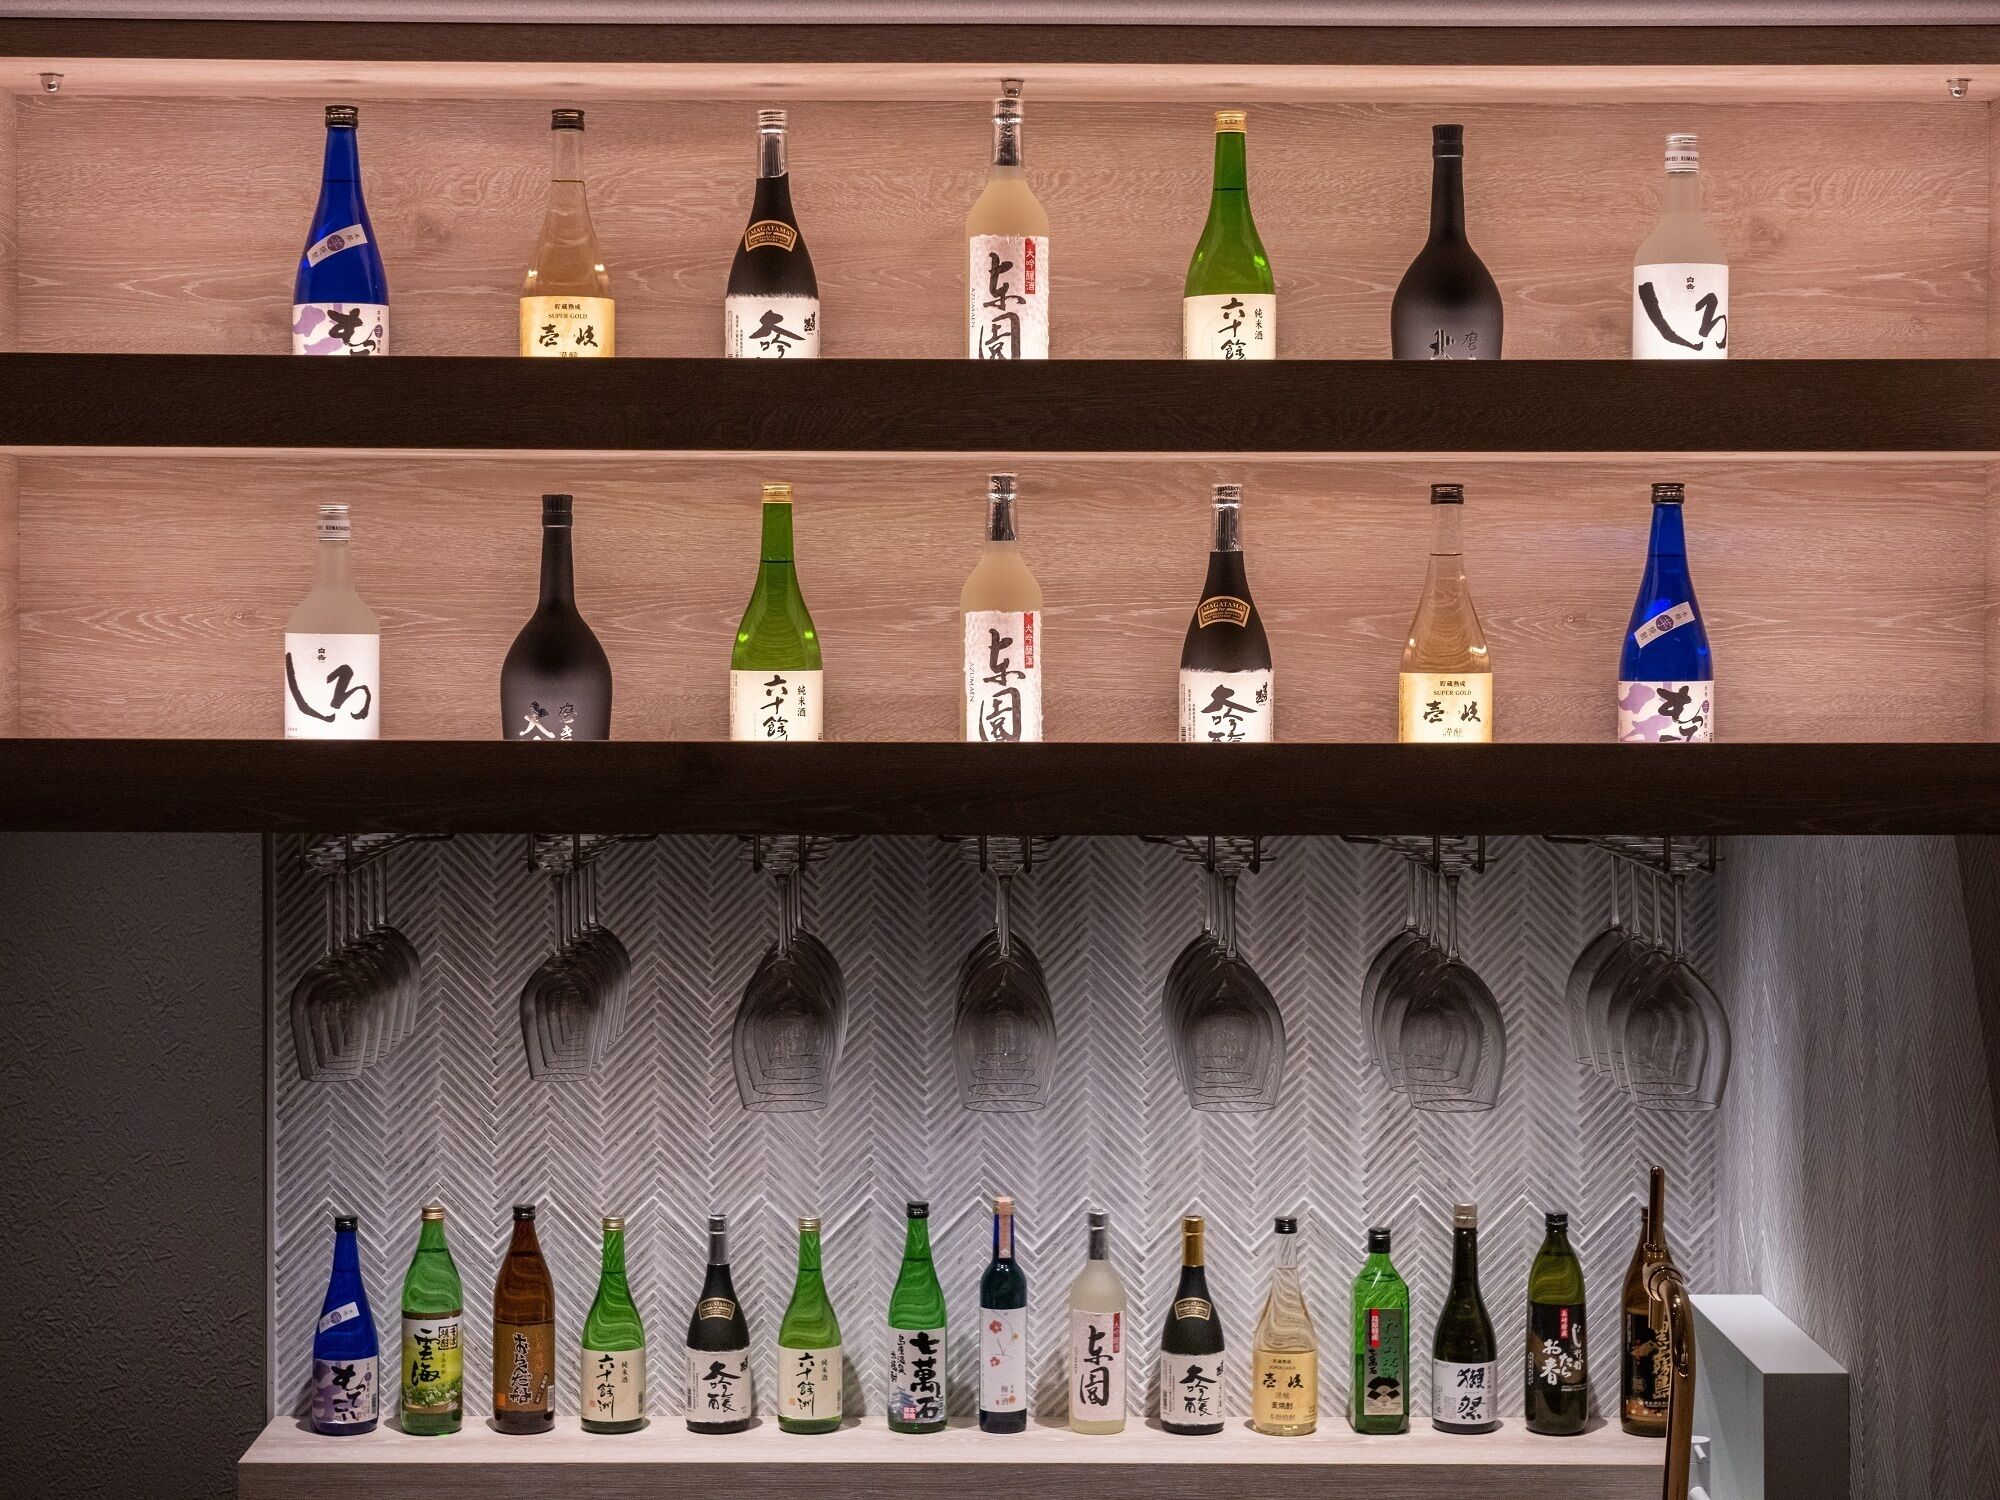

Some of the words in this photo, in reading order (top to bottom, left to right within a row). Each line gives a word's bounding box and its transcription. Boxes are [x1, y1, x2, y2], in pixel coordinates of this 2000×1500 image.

[750, 225, 791, 237] MAGATAMA
[1025, 249, 1035, 292] 大吟醸酒
[554, 303, 581, 311] 貯蔵熟成
[1254, 308, 1263, 340] 純米酒
[1638, 282, 1728, 351] しろ
[538, 323, 599, 348] 壱岐
[1203, 601, 1244, 611] MAGATAMA
[1024, 624, 1034, 668] 大吟醸酒
[285, 652, 372, 723] しろ
[798, 685, 807, 717] 純米酒
[1422, 700, 1481, 724] 壱岐
[411, 1328, 440, 1387] 雲海
[595, 1354, 615, 1419] 六十餘洲
[702, 1361, 741, 1413] 大吟醸
[795, 1352, 815, 1417] 六十餘洲
[1179, 1364, 1218, 1417] 大吟醸
[1262, 1372, 1304, 1389] 壱岐
[1457, 1367, 1486, 1420] 獺祭
